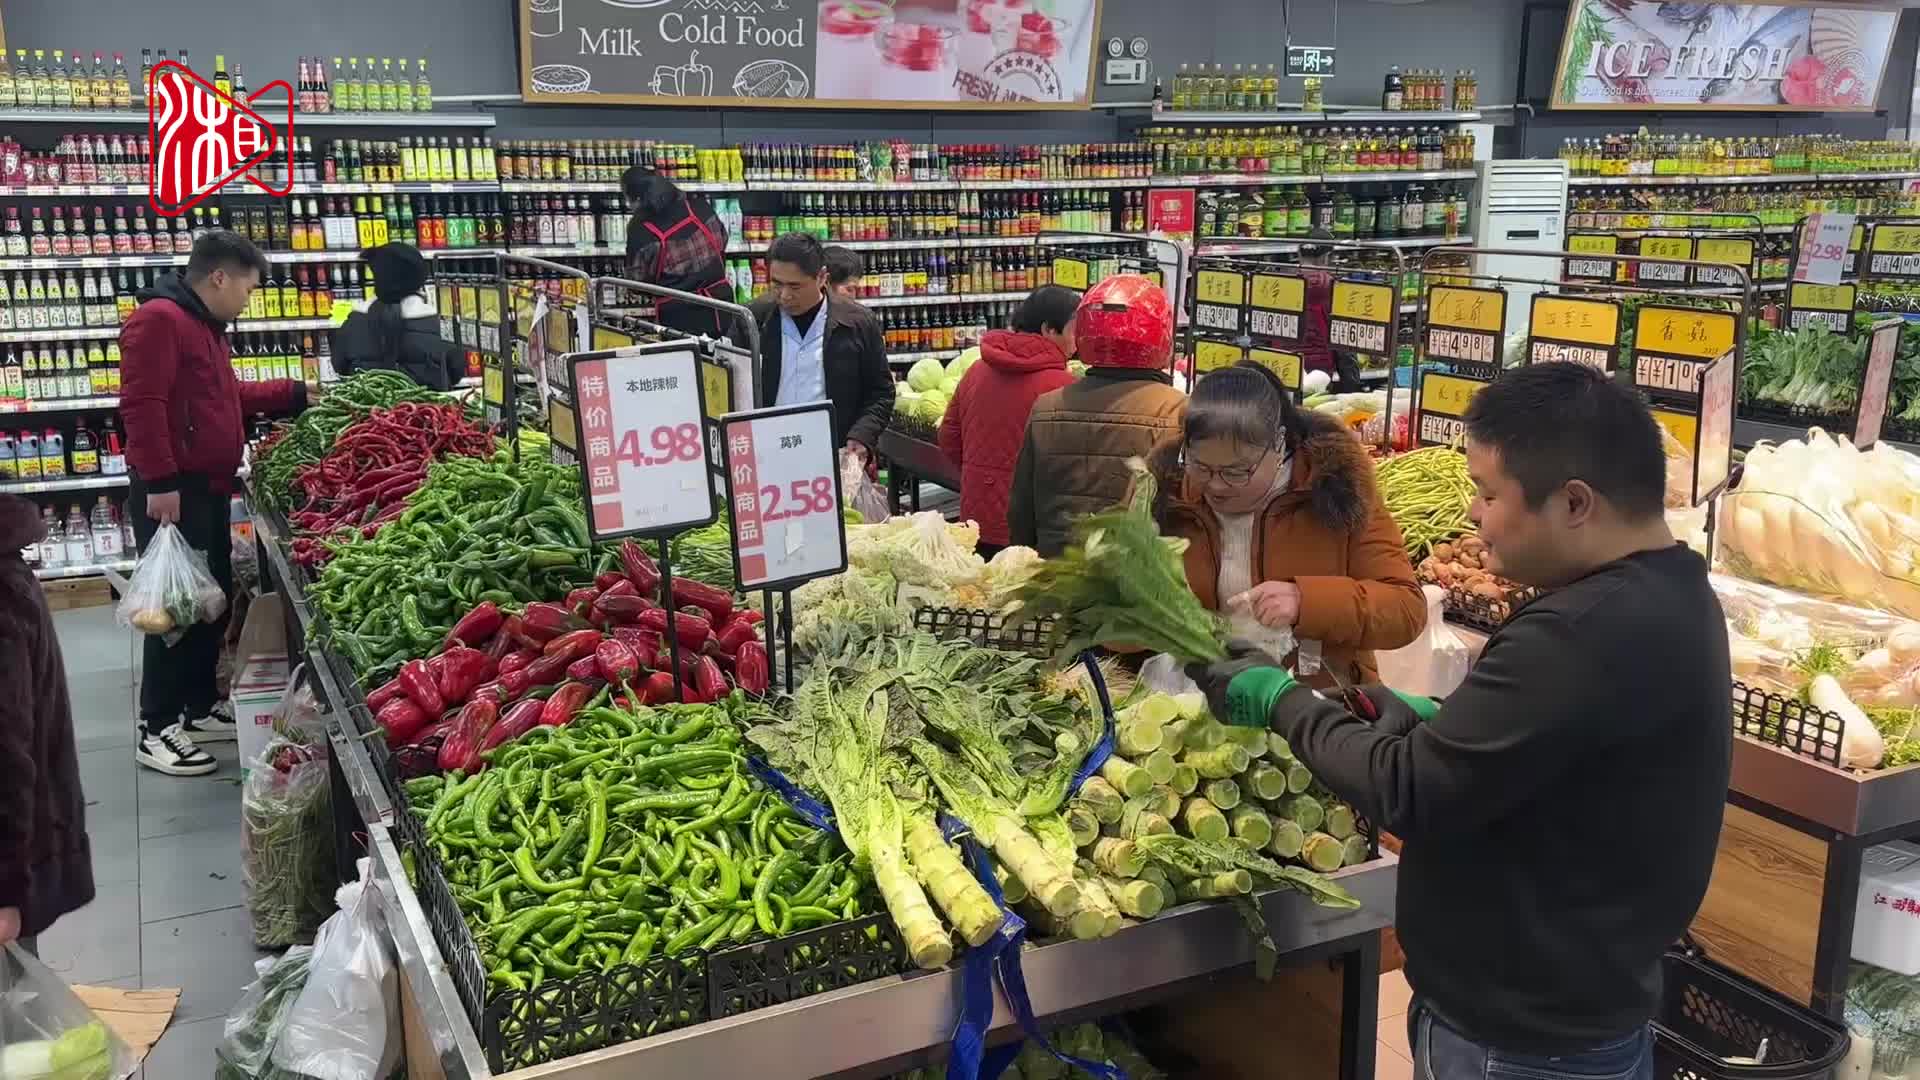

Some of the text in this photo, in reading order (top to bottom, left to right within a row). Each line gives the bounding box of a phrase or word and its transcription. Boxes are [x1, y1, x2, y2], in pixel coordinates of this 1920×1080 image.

[577, 26, 642, 57] Milk
[658, 12, 804, 47] Cold Food
[1584, 41, 1788, 81] ICE FRESH
[1660, 317, 1707, 342] 香菇
[625, 376, 679, 393] 本地辣椒
[581, 376, 615, 489] 特价商品
[613, 422, 703, 467] 4.98
[728, 435, 760, 541] 特价商品
[760, 476, 834, 522] 2.58
